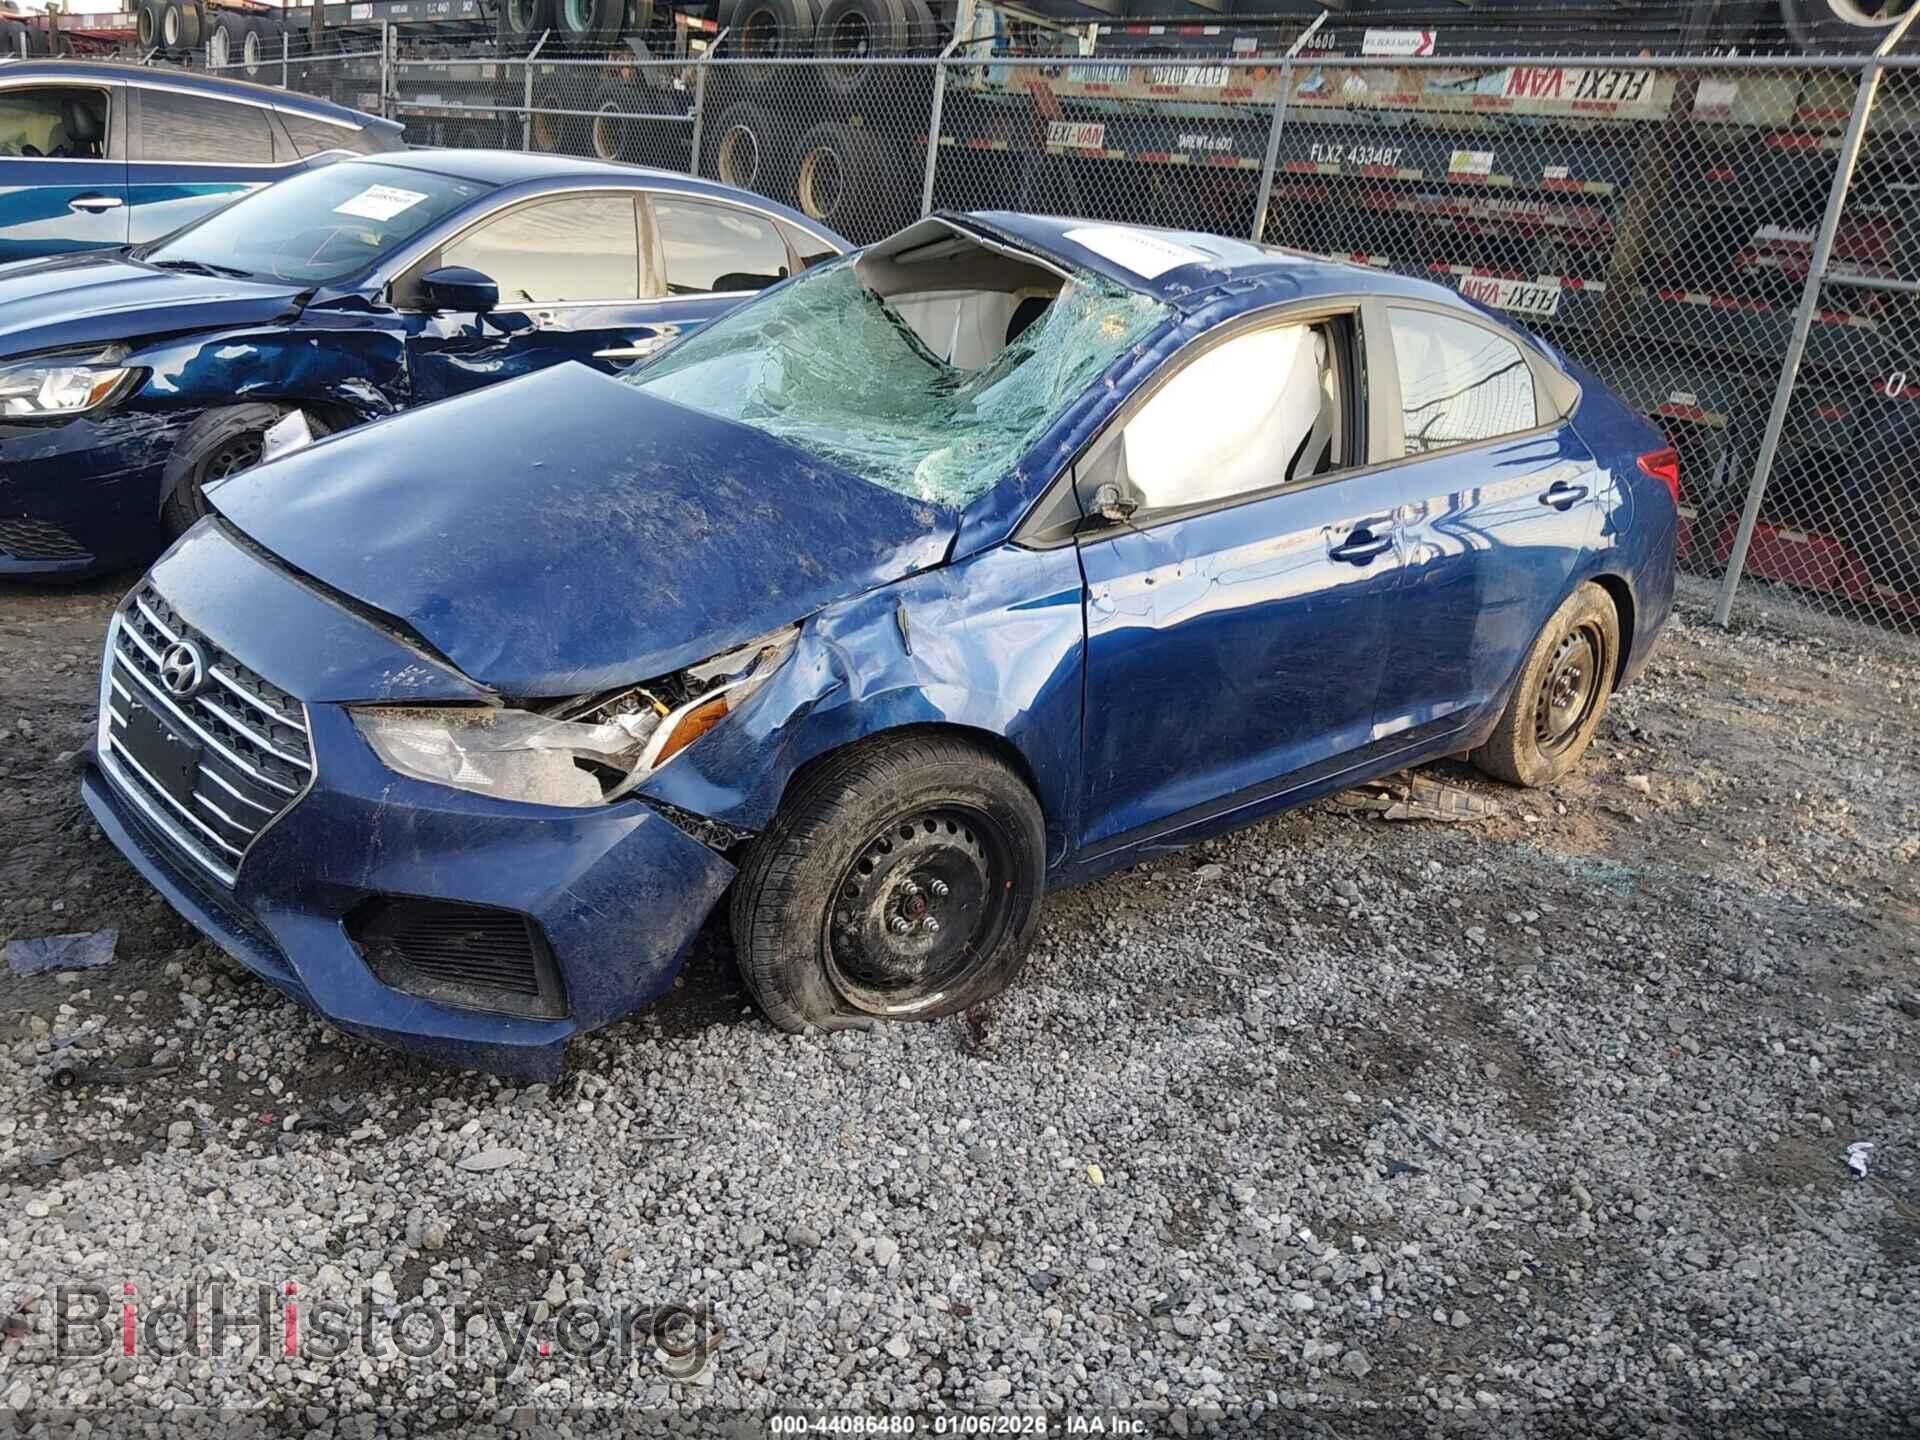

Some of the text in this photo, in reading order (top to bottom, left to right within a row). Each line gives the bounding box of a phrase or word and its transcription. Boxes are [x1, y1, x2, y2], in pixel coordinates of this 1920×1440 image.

[1308, 33, 1335, 49] 6600
[1506, 67, 1650, 101] FLEXI-VAN
[1310, 143, 1402, 166] FLXZ 433487
